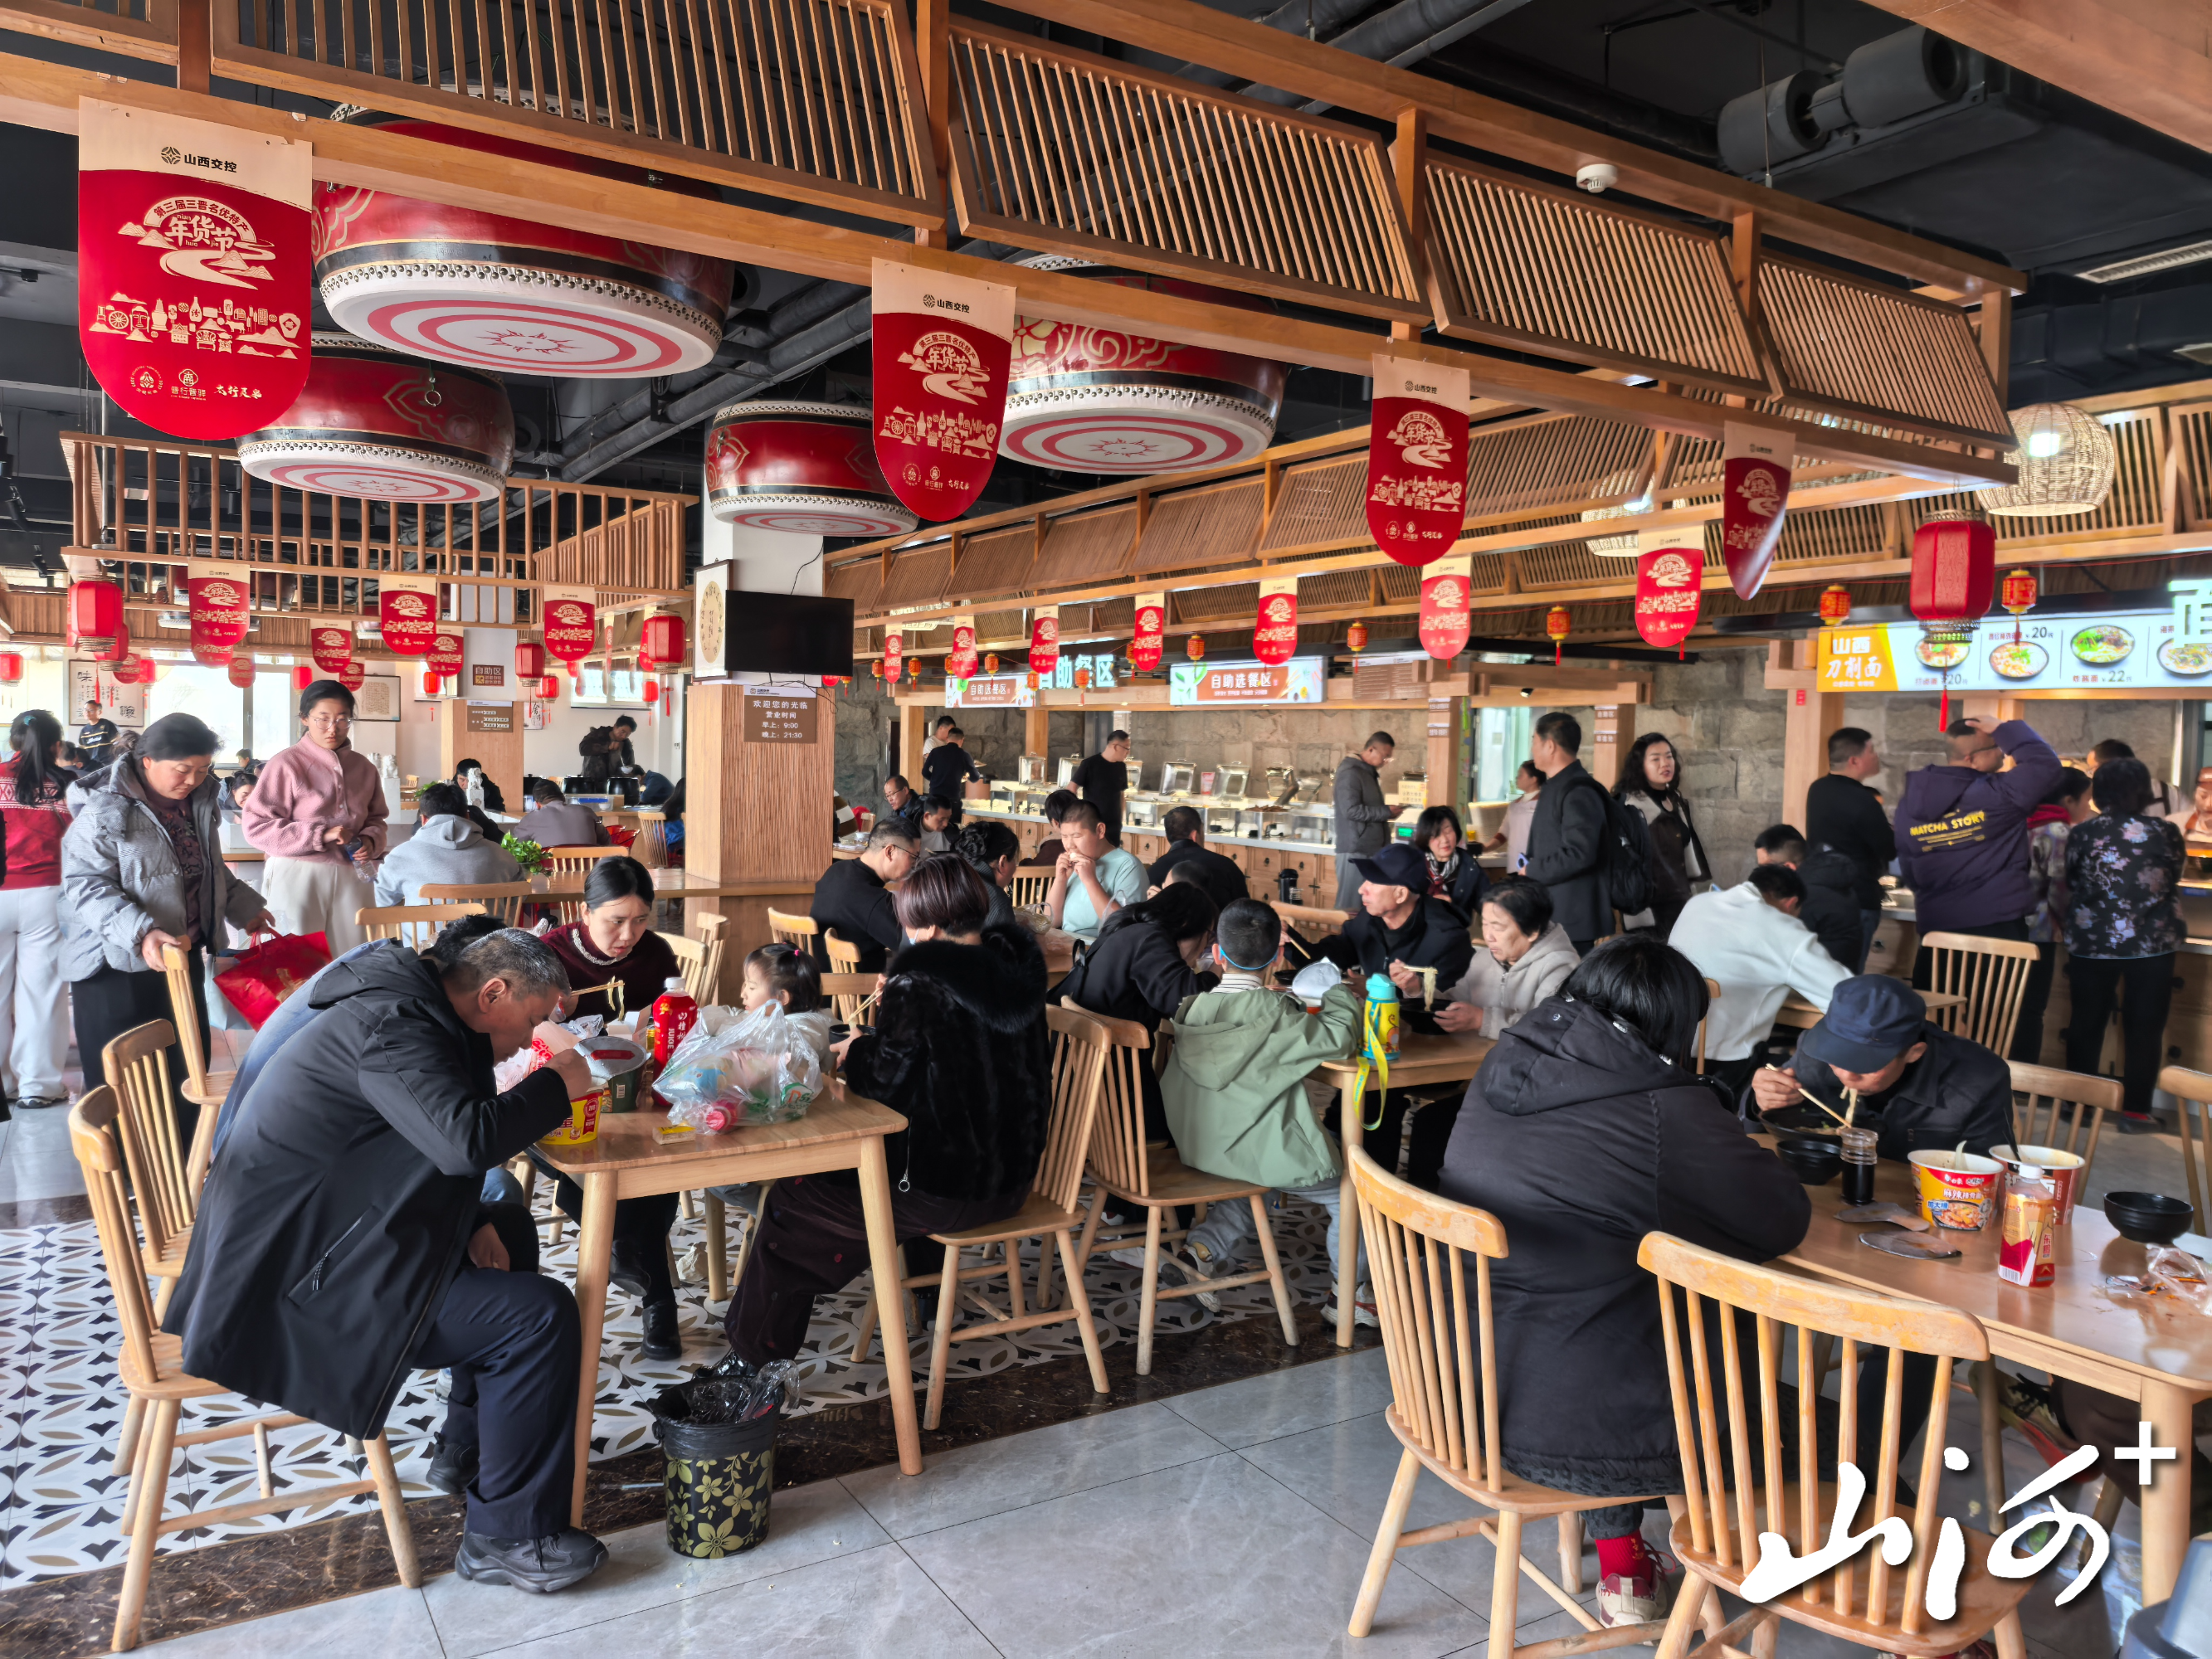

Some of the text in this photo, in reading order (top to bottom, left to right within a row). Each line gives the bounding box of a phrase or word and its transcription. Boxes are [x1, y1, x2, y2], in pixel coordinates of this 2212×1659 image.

[184, 153, 237, 173] 山西交控
[153, 199, 250, 232] 第三届三晋名优特产
[164, 215, 236, 252] 年货节
[937, 299, 970, 314] 山西交控
[925, 346, 969, 376] 年货节
[1833, 636, 1871, 654] 山西
[1825, 655, 1882, 680] 刀削面
[1211, 671, 1272, 688] 自助选餐区
[753, 700, 808, 710] 欢迎您的光临
[765, 711, 797, 719] 营业时间
[1909, 810, 1985, 837] MATCHA STORY
